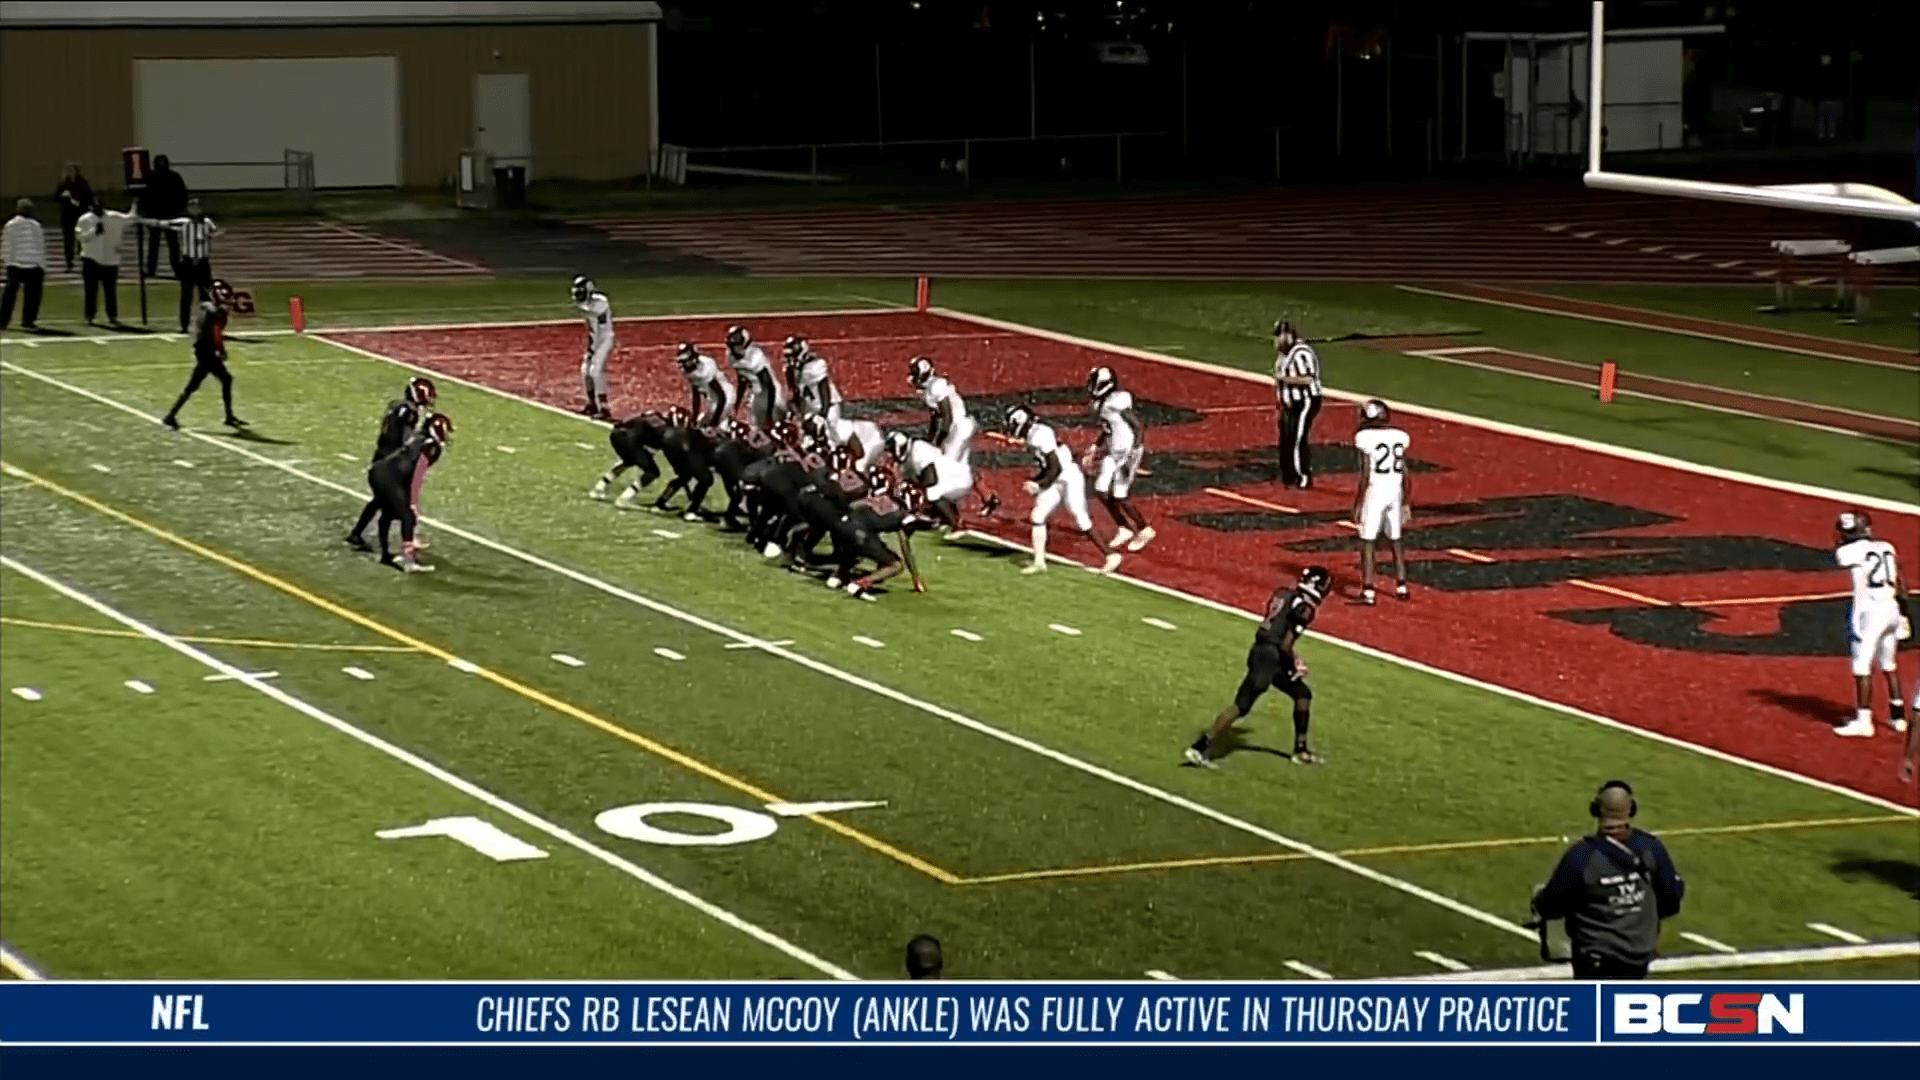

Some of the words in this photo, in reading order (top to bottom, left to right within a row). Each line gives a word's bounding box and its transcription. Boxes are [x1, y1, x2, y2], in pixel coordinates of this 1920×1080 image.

[131, 153, 142, 179] 1
[232, 291, 255, 314] G
[1375, 443, 1405, 474] 28
[374, 801, 779, 862] 10
